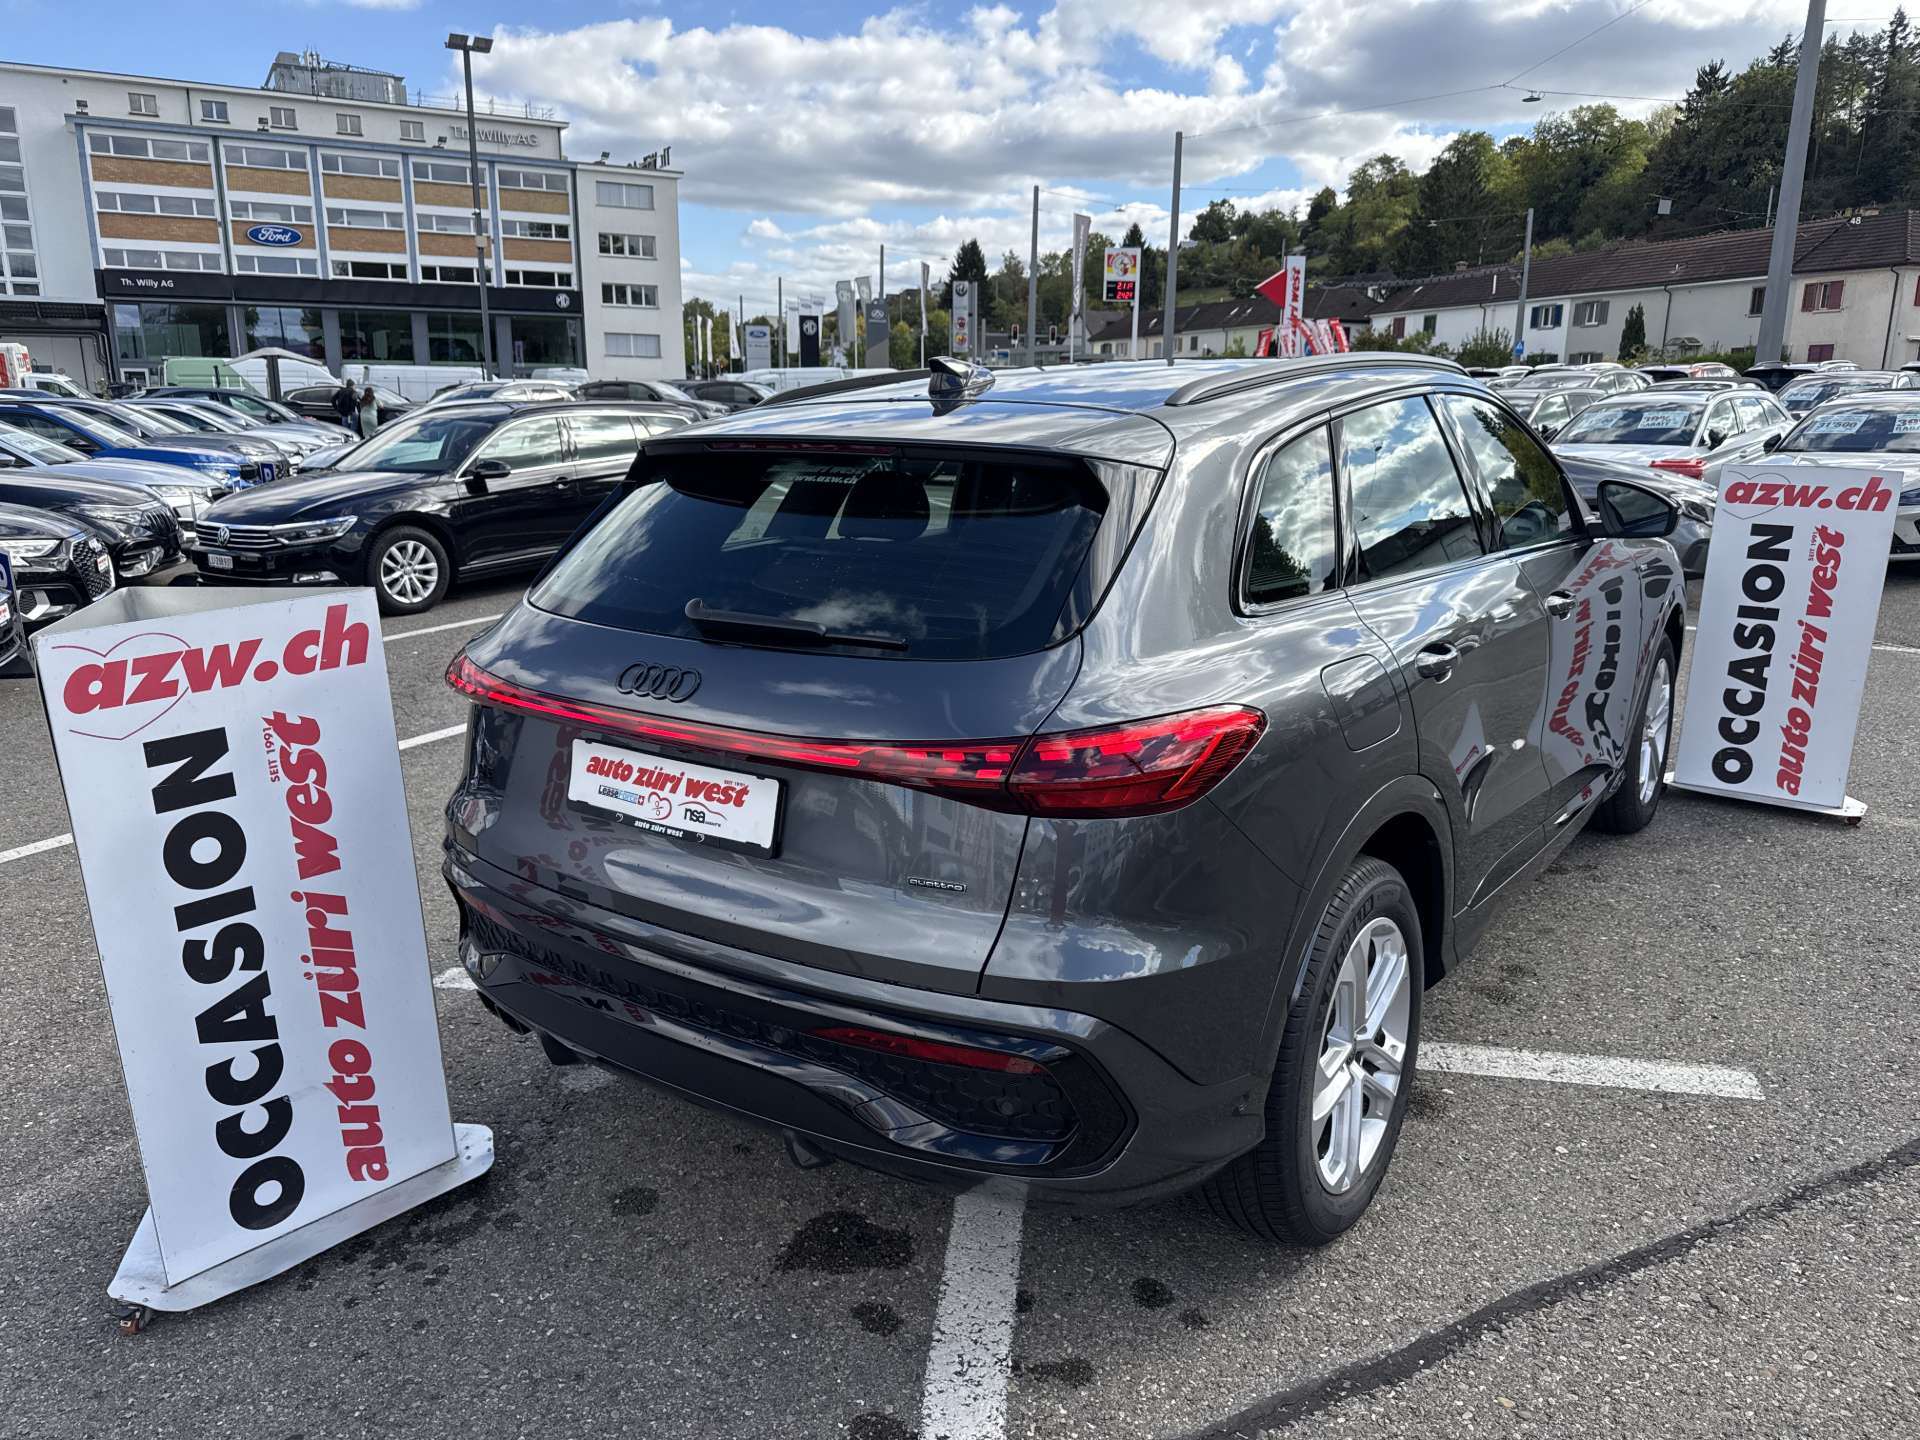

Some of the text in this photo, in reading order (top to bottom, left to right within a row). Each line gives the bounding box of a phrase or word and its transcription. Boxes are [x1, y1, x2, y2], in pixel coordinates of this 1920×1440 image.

[479, 128, 513, 147] Willy
[516, 132, 540, 147] AG
[257, 226, 292, 243] Ford
[1850, 216, 1862, 225] 48
[120, 278, 174, 289] Th. Willy AG
[1724, 476, 1893, 512] azw.ch
[63, 603, 369, 714] azw.ch
[1711, 523, 1795, 784] OCCASION
[1776, 524, 1846, 796] auto züri west
[262, 727, 281, 783] SEIT 1991
[585, 755, 750, 808] auto züri west
[634, 819, 684, 838] auto züri west
[683, 807, 706, 825] nsa
[908, 878, 963, 892] quattro
[260, 710, 391, 1183] auto züri west
[142, 726, 306, 1231] OCCASION
